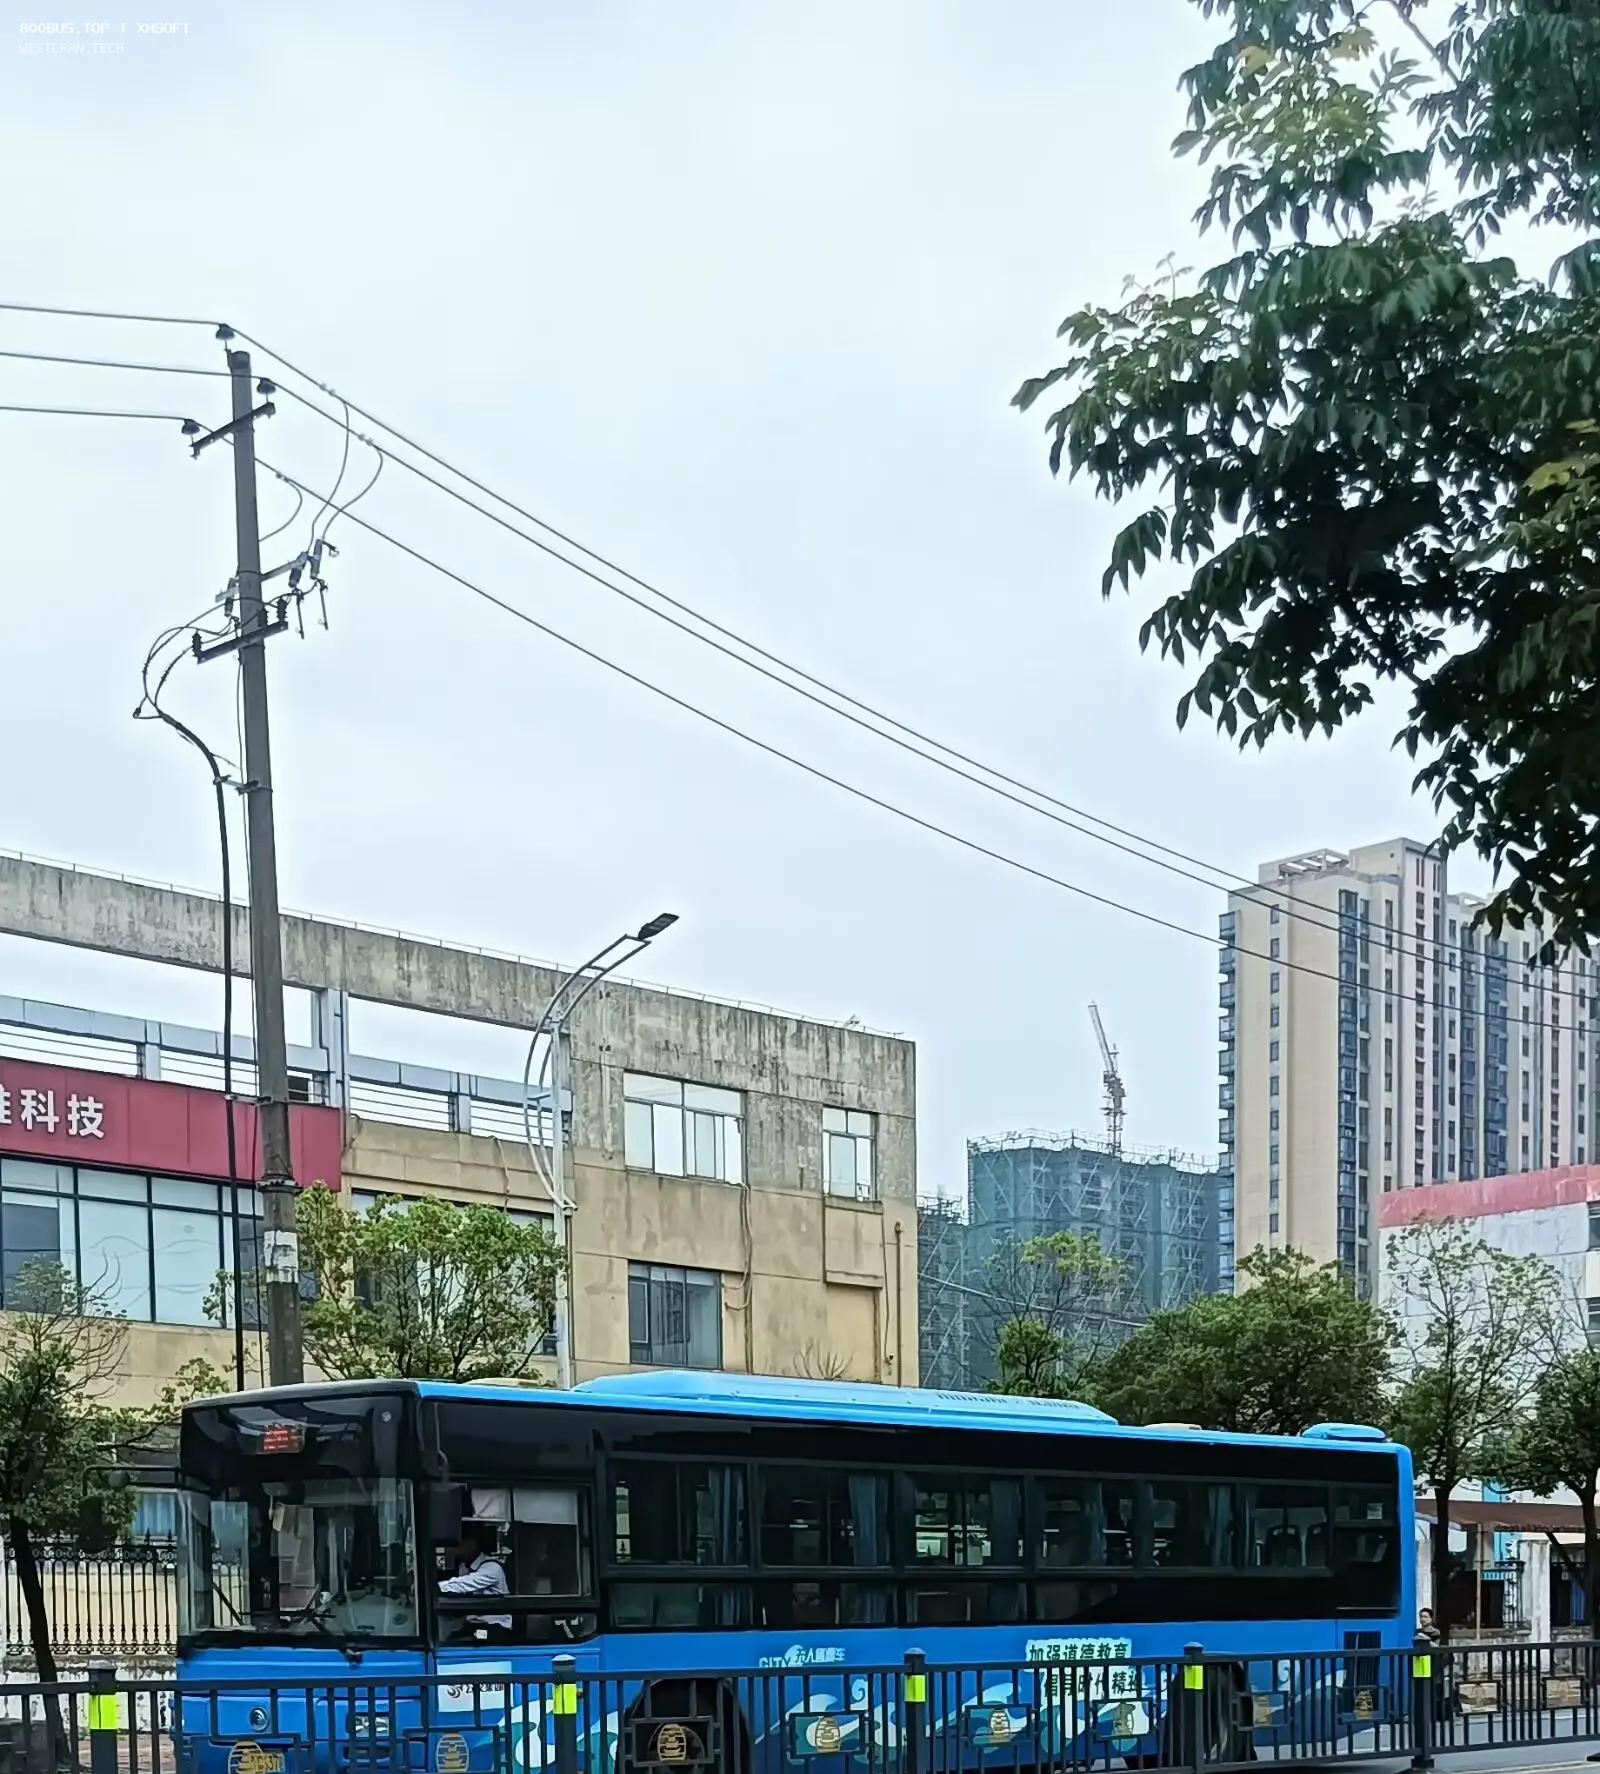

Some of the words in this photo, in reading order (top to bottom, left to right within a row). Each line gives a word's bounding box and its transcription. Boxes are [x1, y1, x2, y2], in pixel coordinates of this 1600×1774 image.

[1029, 1642, 1128, 1660] 加强道德教育
